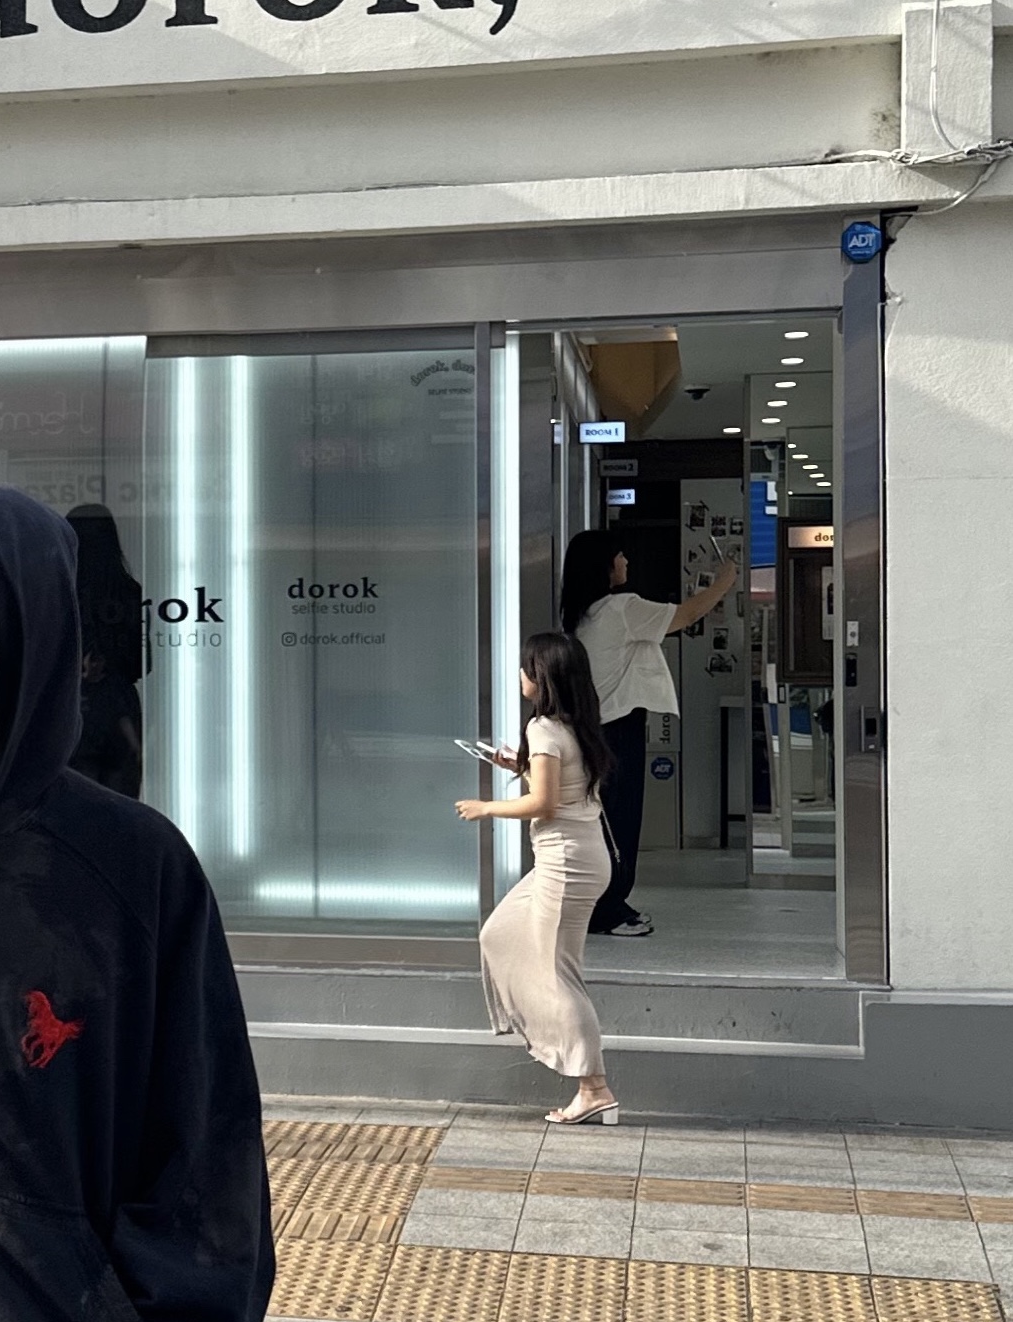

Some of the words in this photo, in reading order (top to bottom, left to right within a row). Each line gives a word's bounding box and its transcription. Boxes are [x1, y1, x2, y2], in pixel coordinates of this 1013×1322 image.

[848, 233, 876, 248] ADT
[288, 577, 379, 599] dorok
[128, 586, 225, 623] rok
[291, 601, 328, 614] selfie
[332, 602, 376, 614] studio
[299, 632, 386, 645] dorok.official
